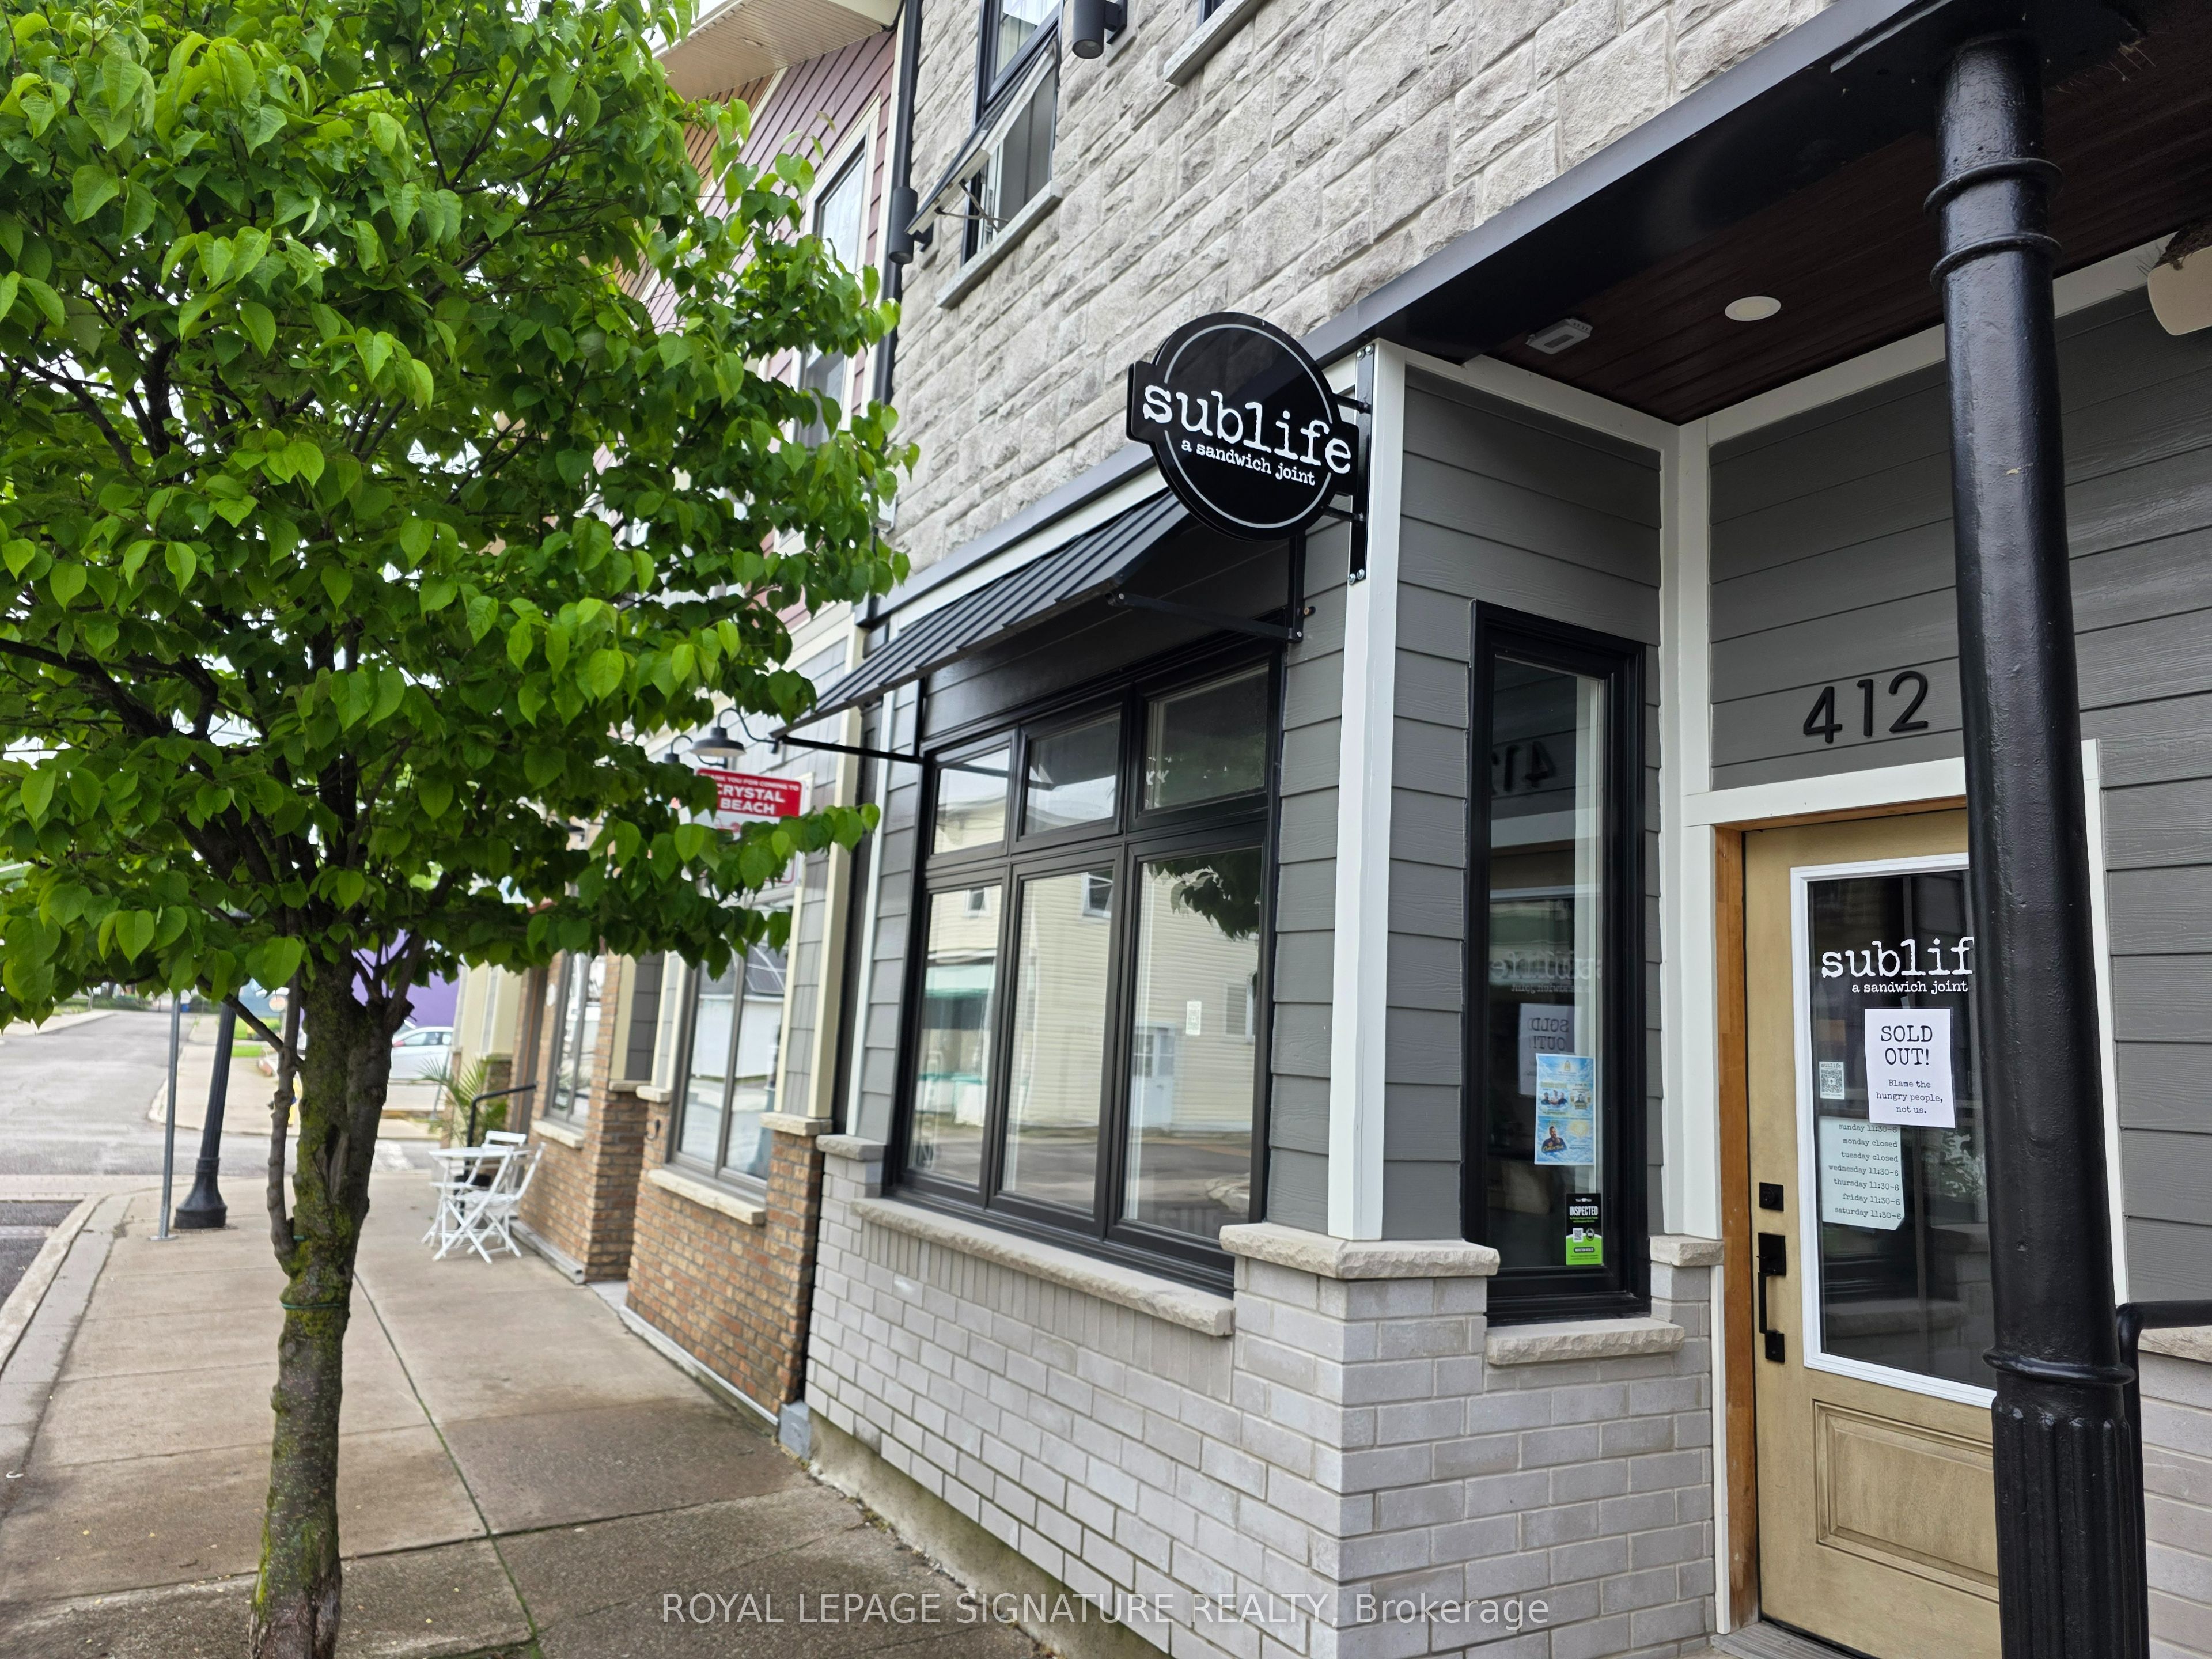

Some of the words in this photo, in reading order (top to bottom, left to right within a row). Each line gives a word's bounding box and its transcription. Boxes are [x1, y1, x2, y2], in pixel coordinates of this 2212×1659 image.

[1143, 385, 1351, 474] sublife
[1181, 438, 1192, 452] a
[1196, 442, 1272, 475] sandwich
[1275, 463, 1316, 486] joint
[1803, 671, 1929, 744] 412
[728, 776, 742, 785] YOU
[720, 798, 776, 815] BEACH
[1821, 936, 1974, 978] sublif
[1851, 983, 1860, 993] a
[1863, 980, 1927, 993] sandwich
[1931, 980, 1968, 995] joint
[1881, 1025, 1933, 1043] SOLD
[1885, 1048, 1930, 1066] OUT!
[1888, 1079, 1914, 1088] Blame
[1916, 1080, 1931, 1088] the
[1876, 1092, 1907, 1101] hungry
[1910, 1093, 1943, 1103] people,
[1896, 1105, 1911, 1114] not
[1839, 1123, 1865, 1132] sunday
[1843, 1138, 1870, 1147] monday
[1872, 1140, 1898, 1148] closed
[1841, 1151, 1870, 1161] tuesday
[1872, 1154, 1899, 1162] closed
[1828, 1164, 1867, 1175] wednesday
[1834, 1179, 1867, 1189] thursday
[1842, 1193, 1868, 1203] friday
[1569, 1206, 1599, 1216] INSPECTED
[1834, 1207, 1868, 1218] saturday
